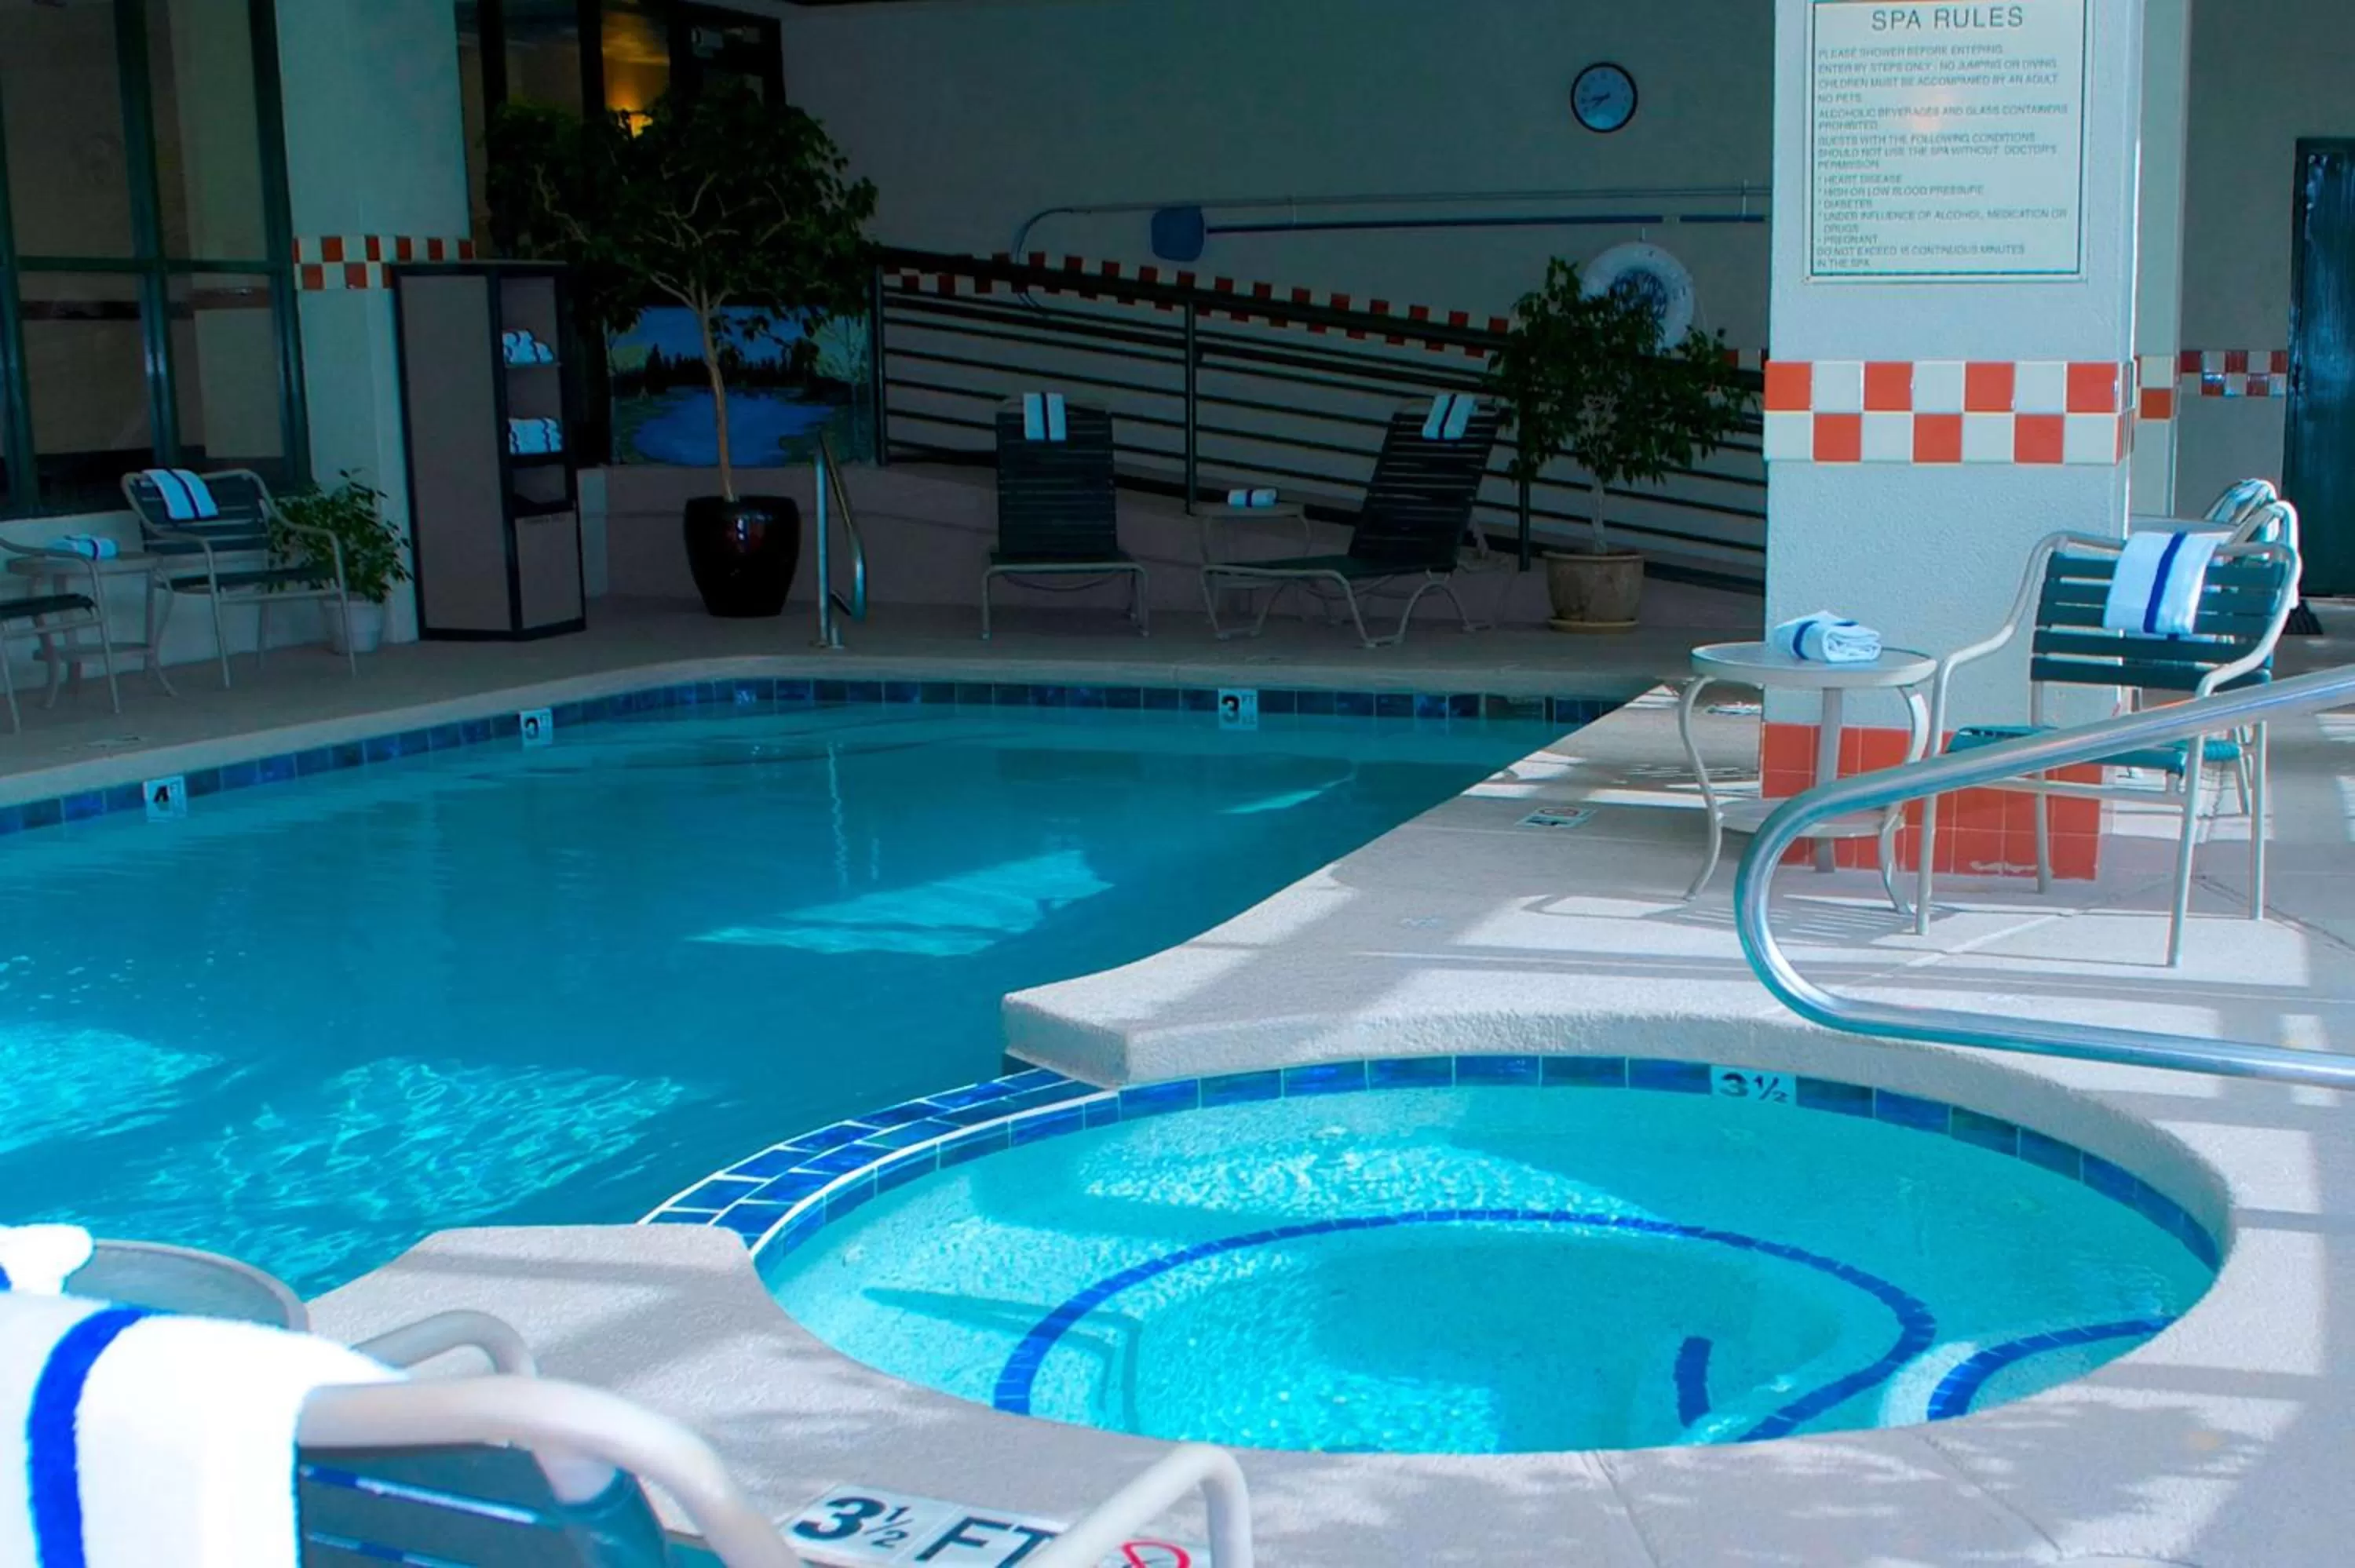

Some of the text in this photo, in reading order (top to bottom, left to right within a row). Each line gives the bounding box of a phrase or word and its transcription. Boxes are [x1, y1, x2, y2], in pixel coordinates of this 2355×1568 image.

[1871, 6, 2023, 31] SPA RULES
[1940, 60, 1955, 71] NO
[2004, 59, 2020, 69] OR
[2010, 75, 2023, 85] AN
[1817, 93, 1861, 103] NO PETS
[1943, 106, 1962, 115] AND
[1966, 105, 1999, 115] GLASS
[1860, 135, 1886, 145] WITH
[1888, 134, 1906, 144] THE
[1918, 210, 1931, 220] OF
[915, 1515, 1061, 1568] FT
